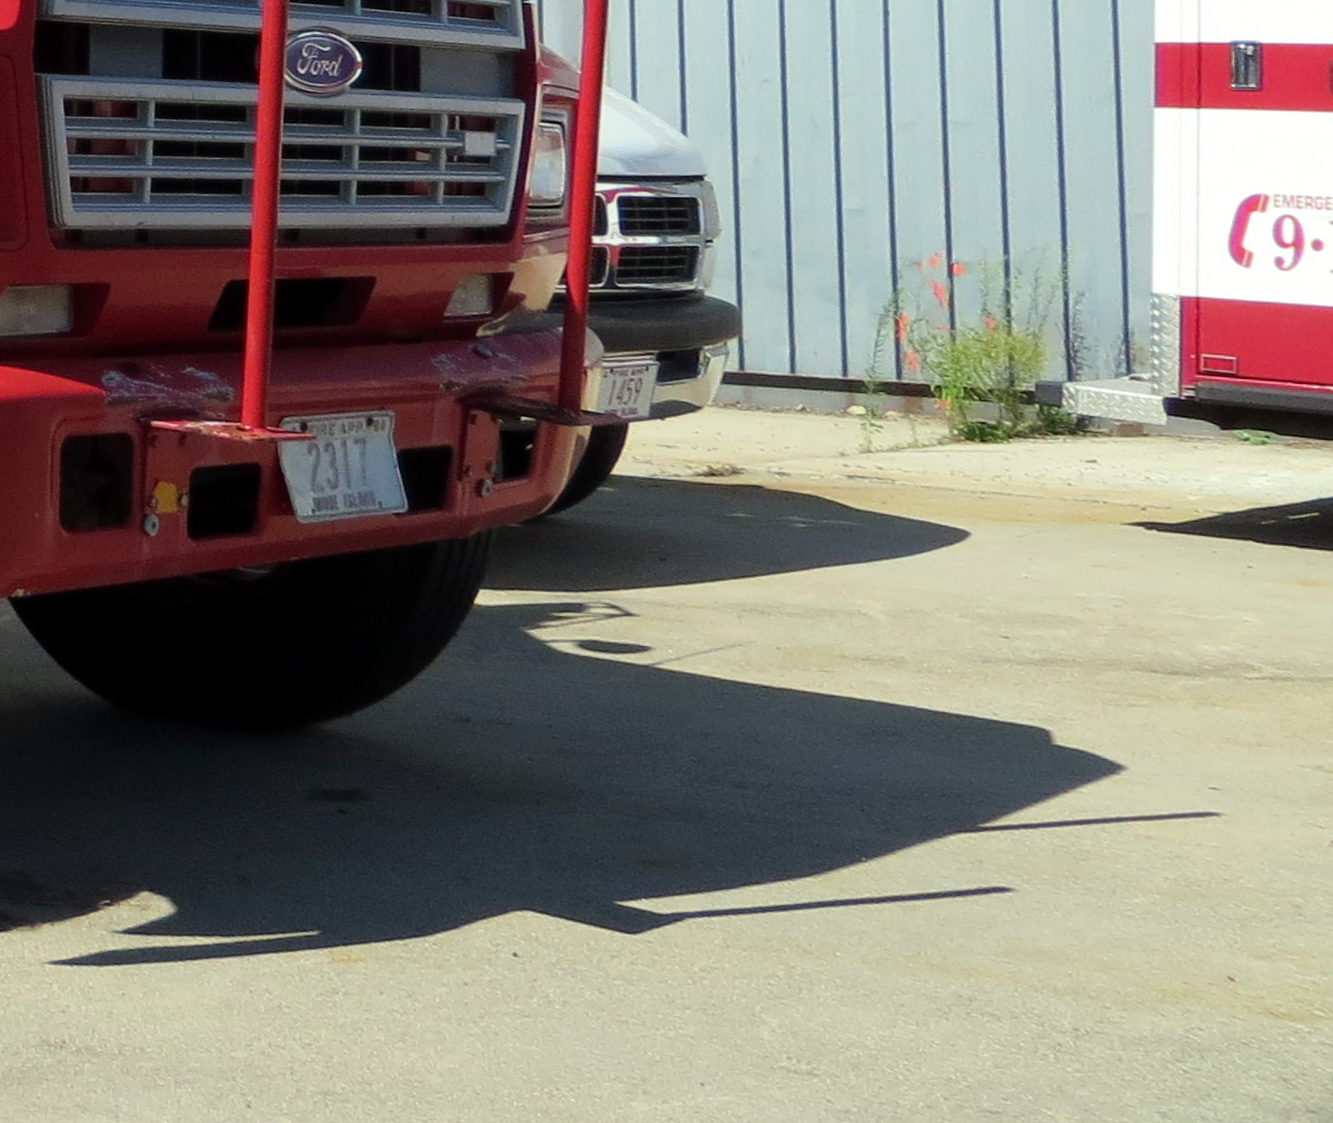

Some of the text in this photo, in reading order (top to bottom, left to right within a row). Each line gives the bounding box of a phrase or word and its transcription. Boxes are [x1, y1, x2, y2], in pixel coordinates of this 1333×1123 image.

[296, 42, 344, 77] Ford
[607, 377, 643, 406] 1459
[307, 437, 368, 494] 2317
